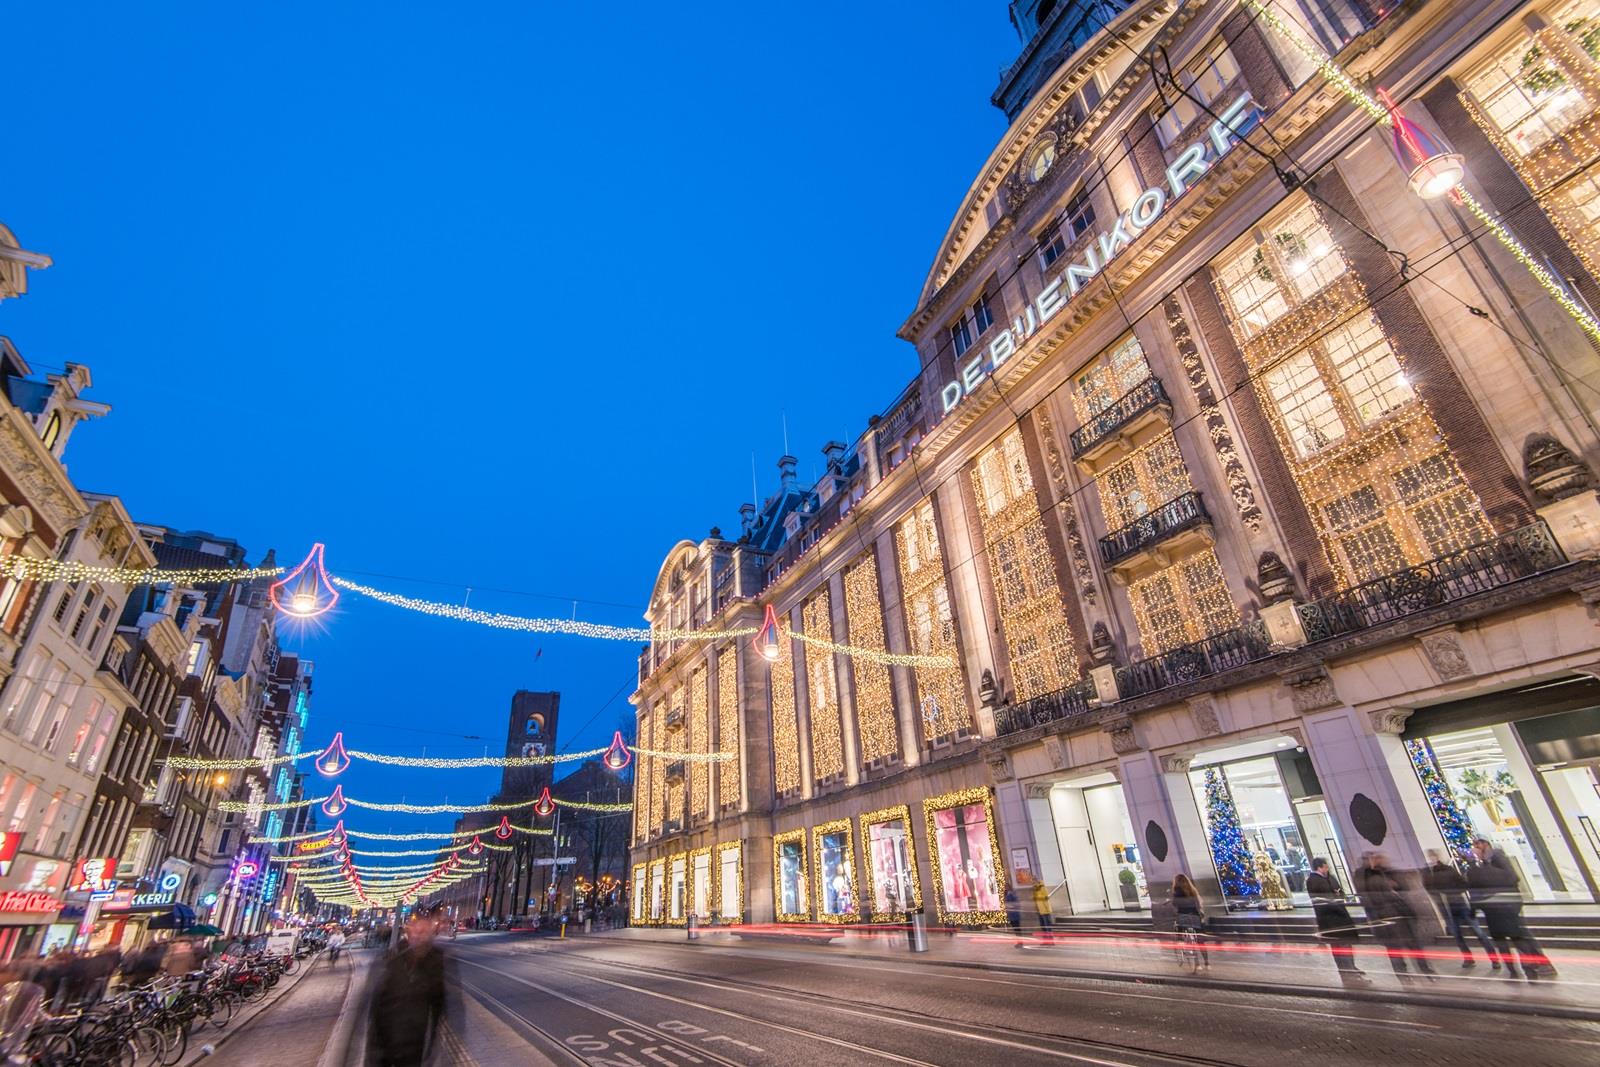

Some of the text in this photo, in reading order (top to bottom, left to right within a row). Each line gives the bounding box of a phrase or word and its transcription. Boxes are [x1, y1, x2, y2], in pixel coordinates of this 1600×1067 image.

[941, 90, 1253, 414] DE BIJENKORF
[566, 1020, 709, 1051] BUS
